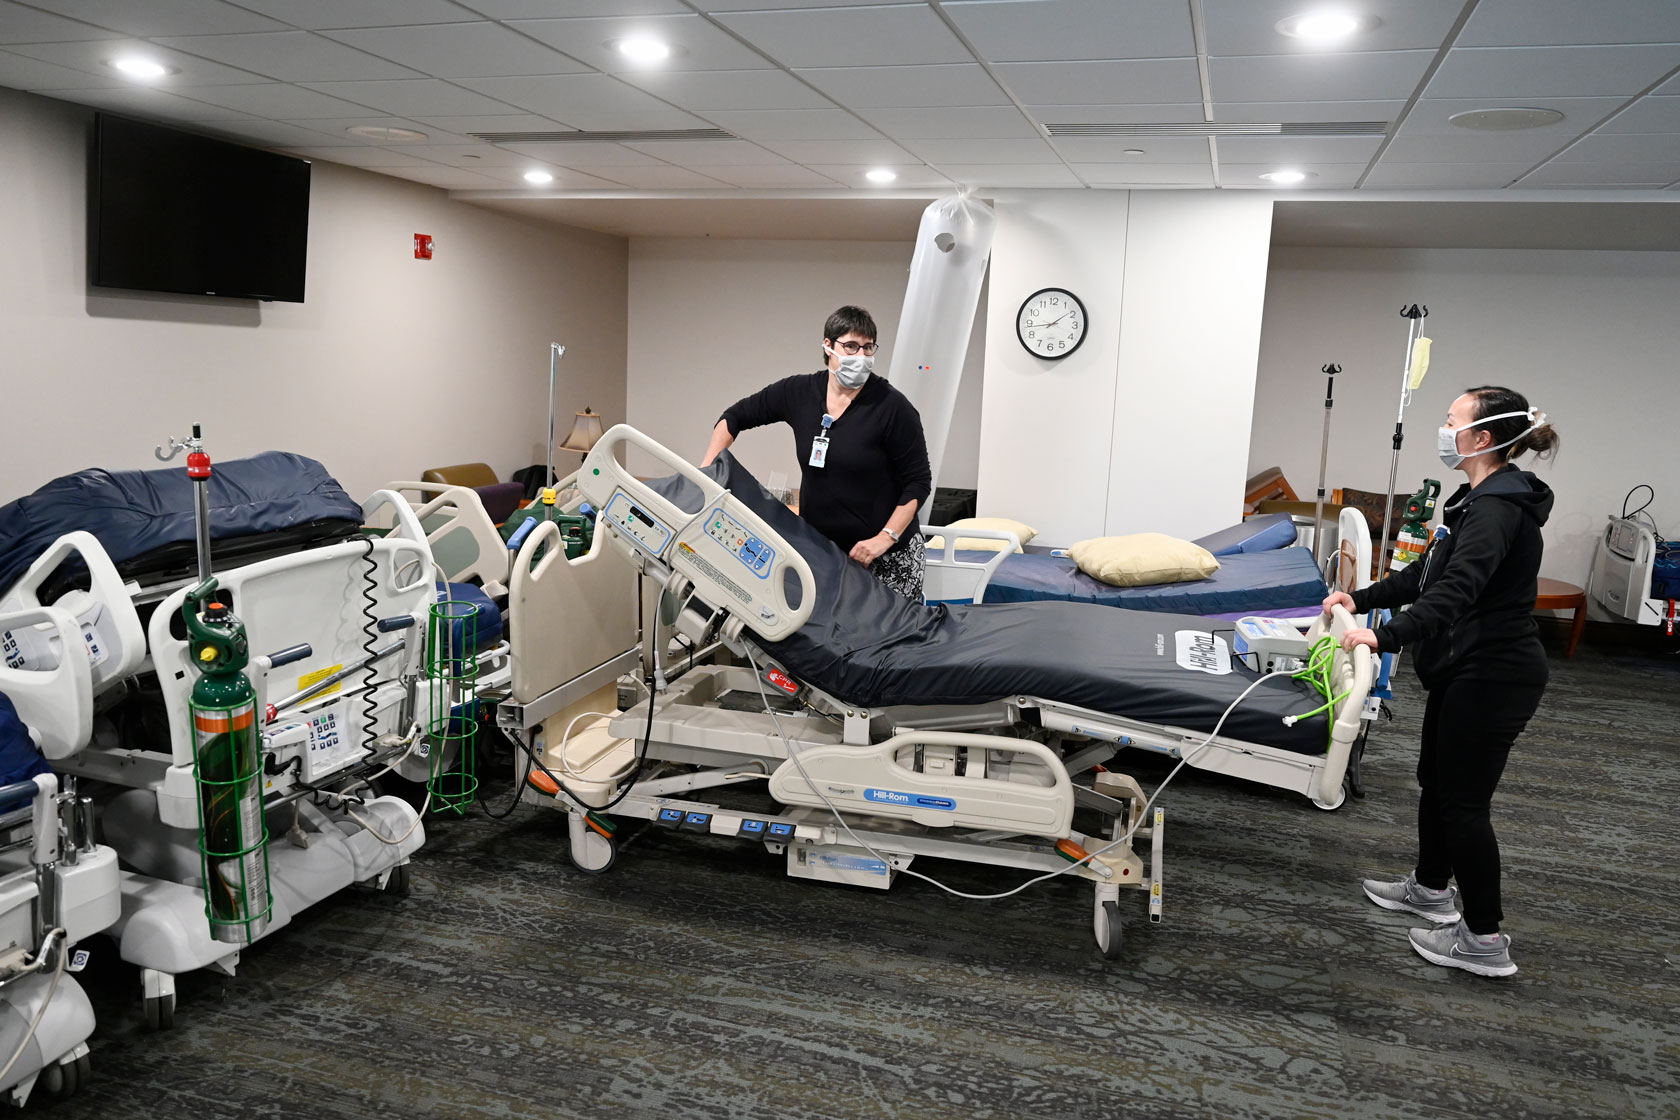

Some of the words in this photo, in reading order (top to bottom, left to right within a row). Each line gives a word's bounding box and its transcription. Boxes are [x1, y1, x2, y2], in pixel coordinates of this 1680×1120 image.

[1039, 300, 1047, 308] 11
[1049, 297, 1059, 306] 12
[1063, 301, 1067, 309] 1
[1030, 309, 1040, 317] 10
[1069, 310, 1077, 319] 2
[1026, 319, 1033, 328] 9
[1072, 321, 1079, 330] 3
[1028, 331, 1035, 339] 8
[1046, 343, 1054, 352] 6
[1058, 340, 1066, 349] 5
[1189, 635, 1218, 671] Hill-Rom
[778, 674, 792, 686] CPR
[873, 790, 909, 802] Hill-Rom
